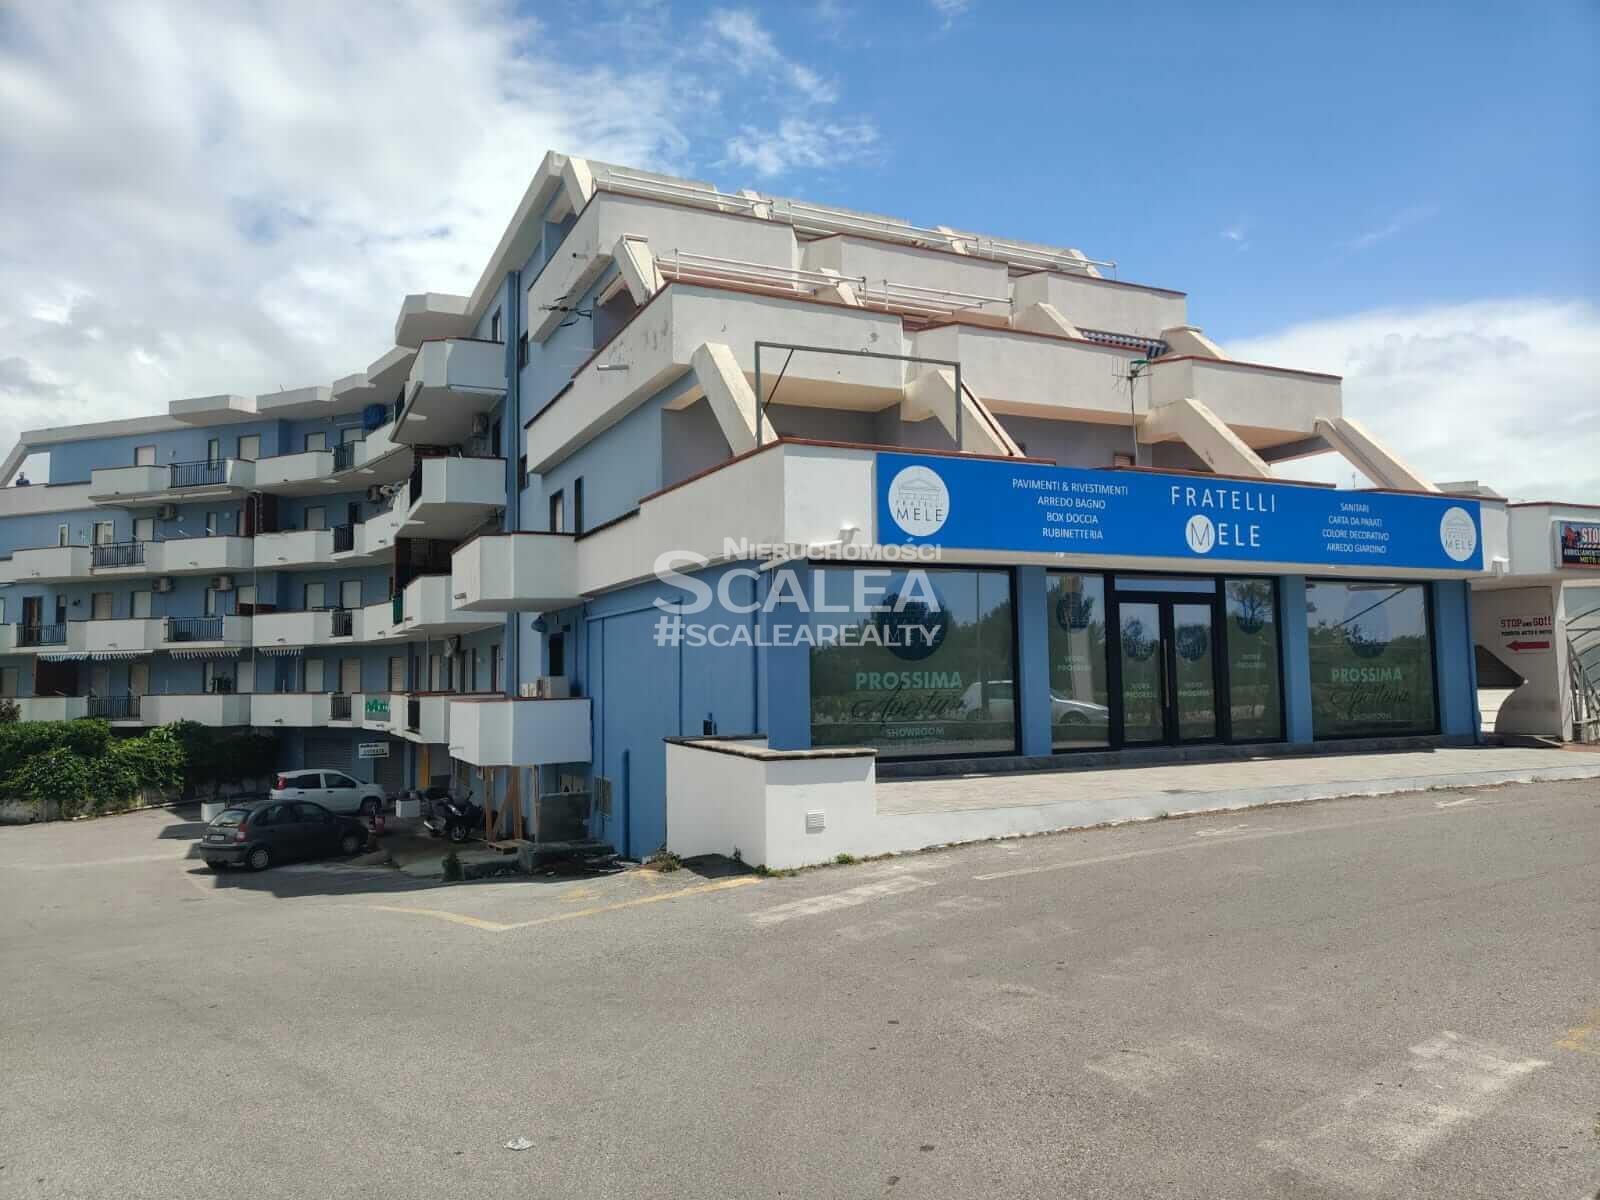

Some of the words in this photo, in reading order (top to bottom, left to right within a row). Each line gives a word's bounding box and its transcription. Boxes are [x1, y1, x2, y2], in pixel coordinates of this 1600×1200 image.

[1012, 478, 1060, 491] PAVIMENTI
[1062, 481, 1069, 492] &
[1071, 482, 1129, 496] RIVESTIMENTI
[1037, 495, 1073, 508] ARREDO
[1075, 497, 1106, 510] BAGNO
[1170, 486, 1275, 513] FRATELLI
[896, 507, 944, 522] MELE
[1340, 502, 1370, 513] SANITARI
[1046, 511, 1065, 522] BOX
[1066, 512, 1099, 525] DOCCIA
[1328, 514, 1349, 525] CARTA
[1350, 516, 1360, 526] DA
[1042, 527, 1104, 540] RUBINETTERIA
[1190, 522, 1261, 547] MELE
[1322, 527, 1348, 539] COLORE
[1349, 529, 1390, 542] DECORATIVO
[1327, 542, 1353, 553] ARREDO
[1354, 543, 1387, 554] GIARDINO
[1501, 618, 1522, 627] STOP
[855, 671, 962, 689] PROSSIMA
[1331, 667, 1402, 683] PROSSIMA
[887, 727, 945, 737] SHOWROOM
